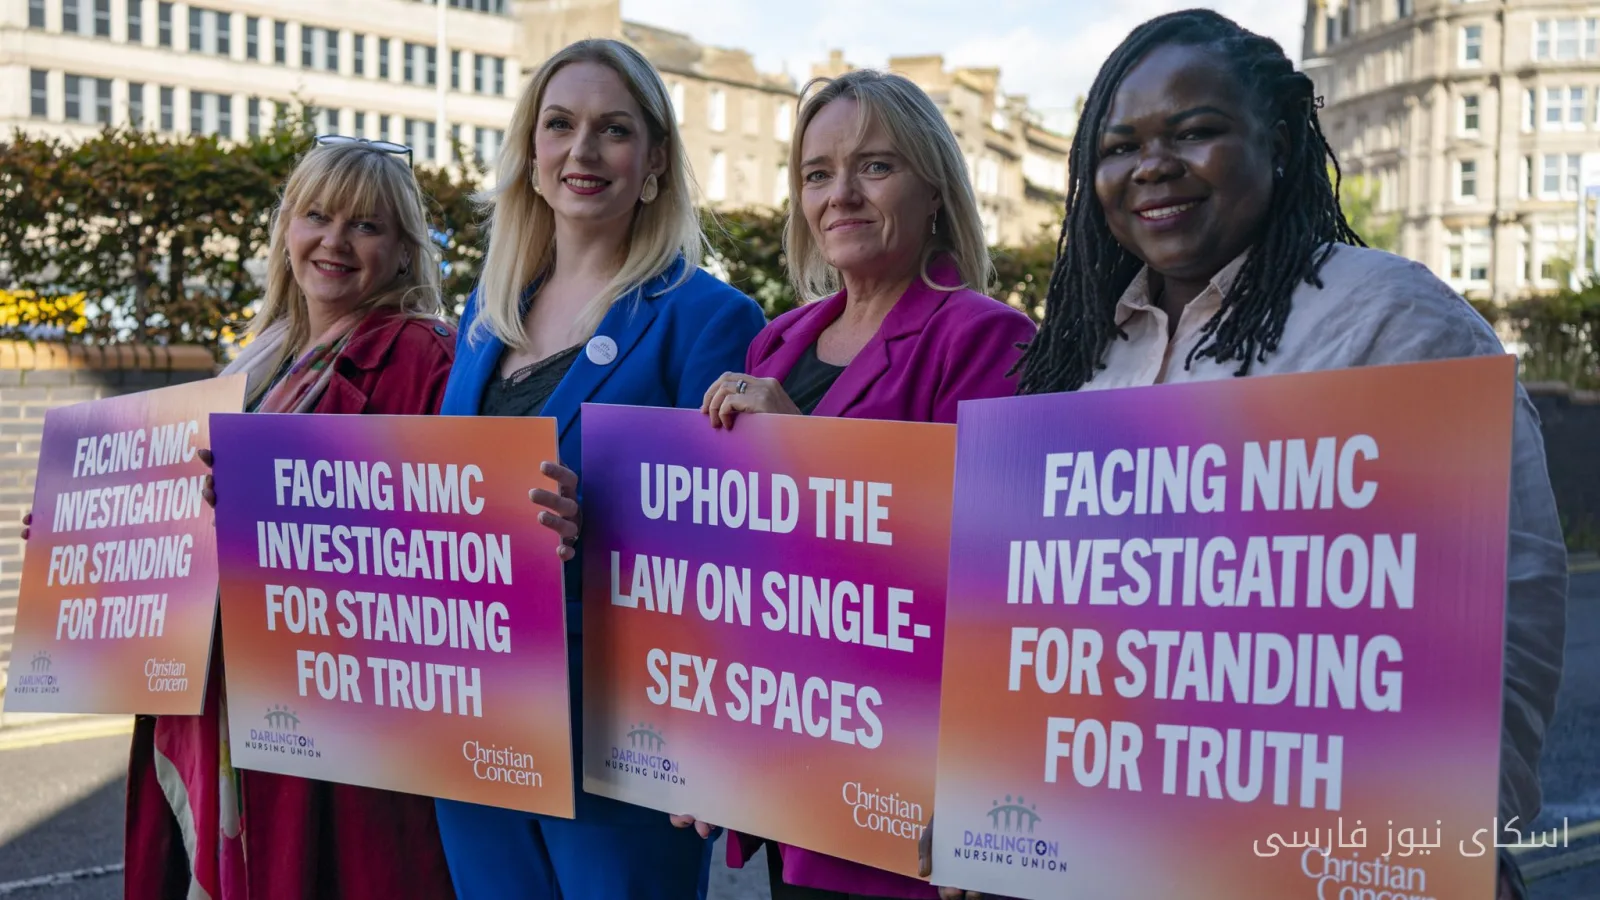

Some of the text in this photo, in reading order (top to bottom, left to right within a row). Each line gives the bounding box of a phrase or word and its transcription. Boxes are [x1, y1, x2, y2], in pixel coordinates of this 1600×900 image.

[73, 420, 199, 478] FACING NMC
[1042, 434, 1379, 518] FACING NMC
[53, 474, 205, 533] INVESTIGATION
[274, 458, 485, 515] FACING NMC
[640, 462, 893, 546] UPHOLD THE
[47, 533, 193, 587] FOR STANDING
[256, 521, 513, 585] INVESTIGATION
[1007, 533, 1417, 609] INVESTIGATION
[56, 593, 168, 640] FOR TRUTH
[265, 584, 511, 653] FOR STANDING
[611, 550, 931, 653] LAW ON SINGLE-
[144, 657, 186, 677] Christian
[148, 673, 188, 692] Concern
[297, 649, 482, 718] FOR TRUTH
[1008, 627, 1403, 713] FOR STANDING
[646, 648, 883, 749] SEX SPACES
[245, 740, 321, 759] NURSING UNION
[250, 728, 315, 749] DARLINGTON
[462, 740, 534, 770] Christian
[611, 746, 679, 774] DARLINGTON
[1044, 716, 1344, 811] FOR TRUTH
[473, 759, 543, 788] Concern
[605, 759, 686, 786] NURSING UNION
[842, 781, 922, 822] Christian
[954, 848, 1068, 873] NURSING UNION
[963, 829, 1060, 858] DARLINGTON
[1300, 847, 1426, 892] Christian
